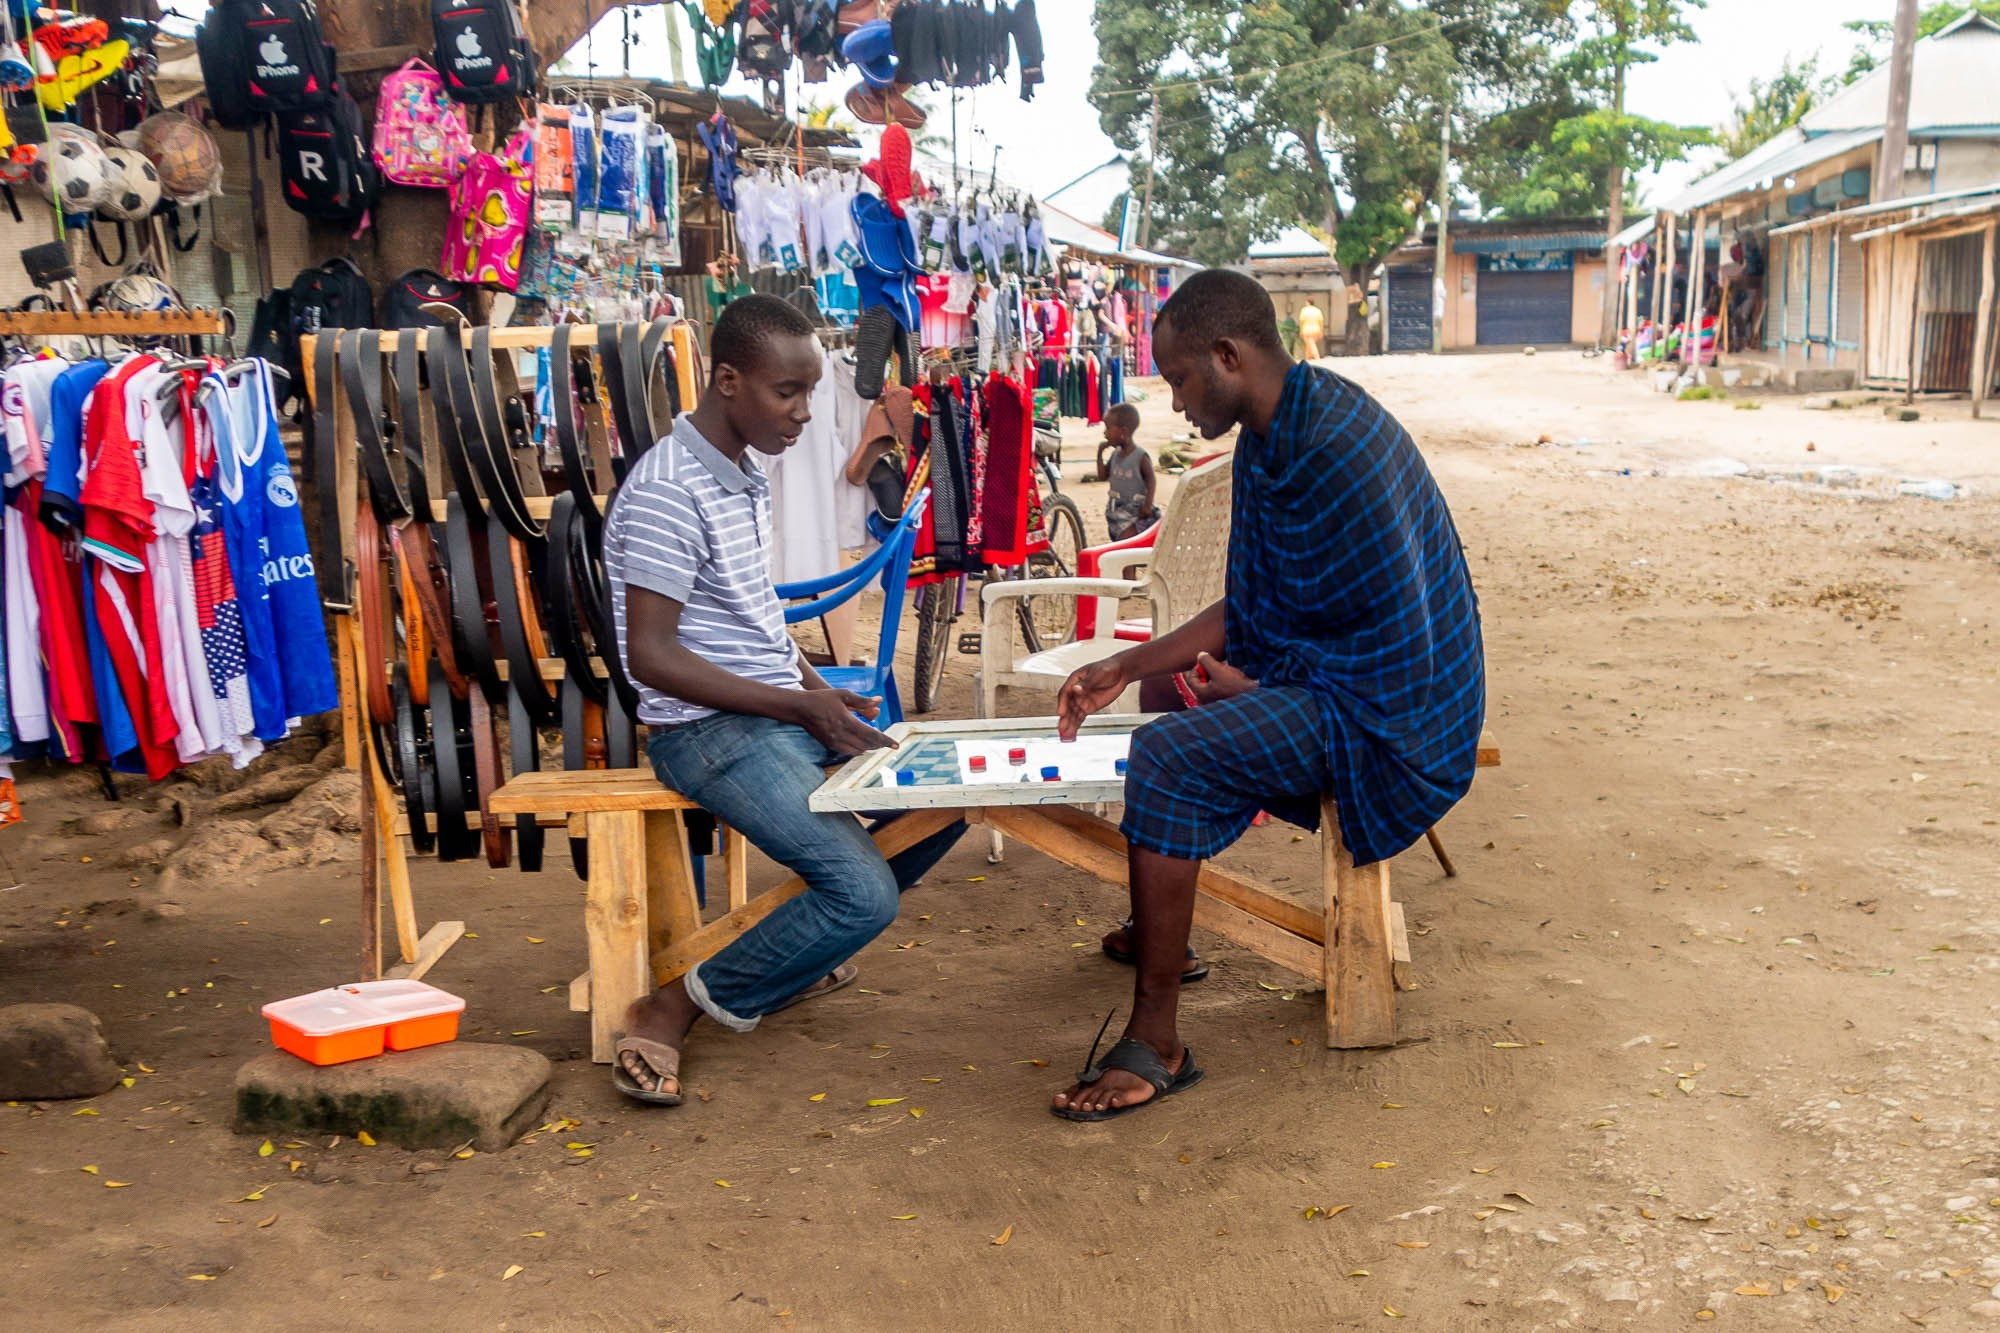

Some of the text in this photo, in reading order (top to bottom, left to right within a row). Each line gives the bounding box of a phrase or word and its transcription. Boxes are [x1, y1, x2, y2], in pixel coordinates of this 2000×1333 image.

[256, 64, 300, 78] iPhone
[454, 56, 493, 70] iPhone
[299, 150, 328, 181] R
[261, 553, 315, 587] ates
